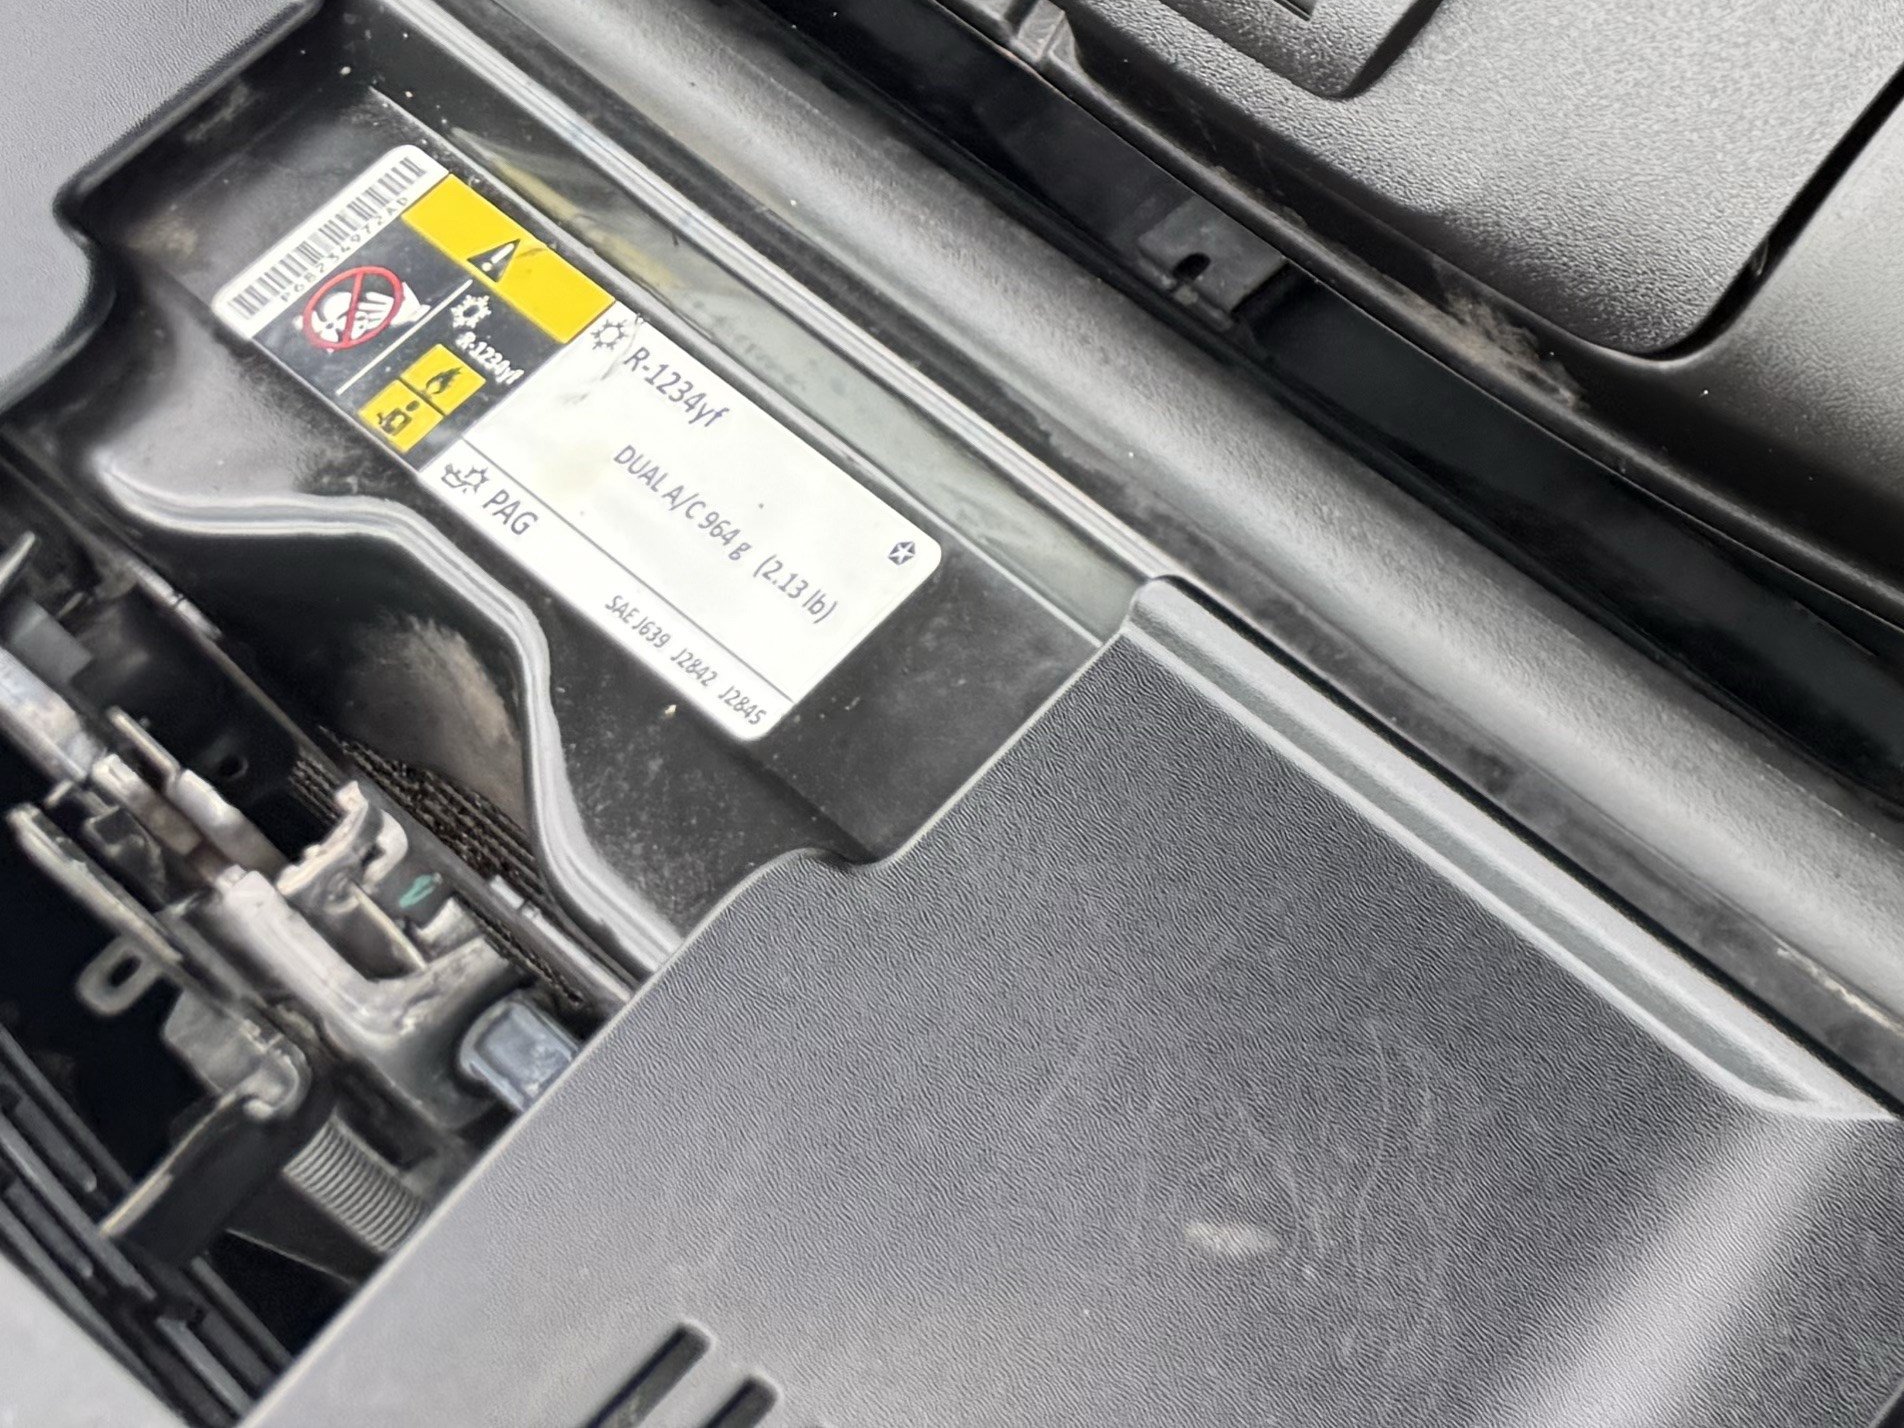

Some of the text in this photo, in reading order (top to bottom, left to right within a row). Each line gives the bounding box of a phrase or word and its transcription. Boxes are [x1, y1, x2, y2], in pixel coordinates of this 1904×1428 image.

[623, 346, 730, 428] R-1234yf
[482, 489, 538, 536] PAG
[613, 445, 838, 624] DUAL A/C 964 g (2.13 lb)
[604, 595, 767, 725] SAE J639 J2842 J2845
